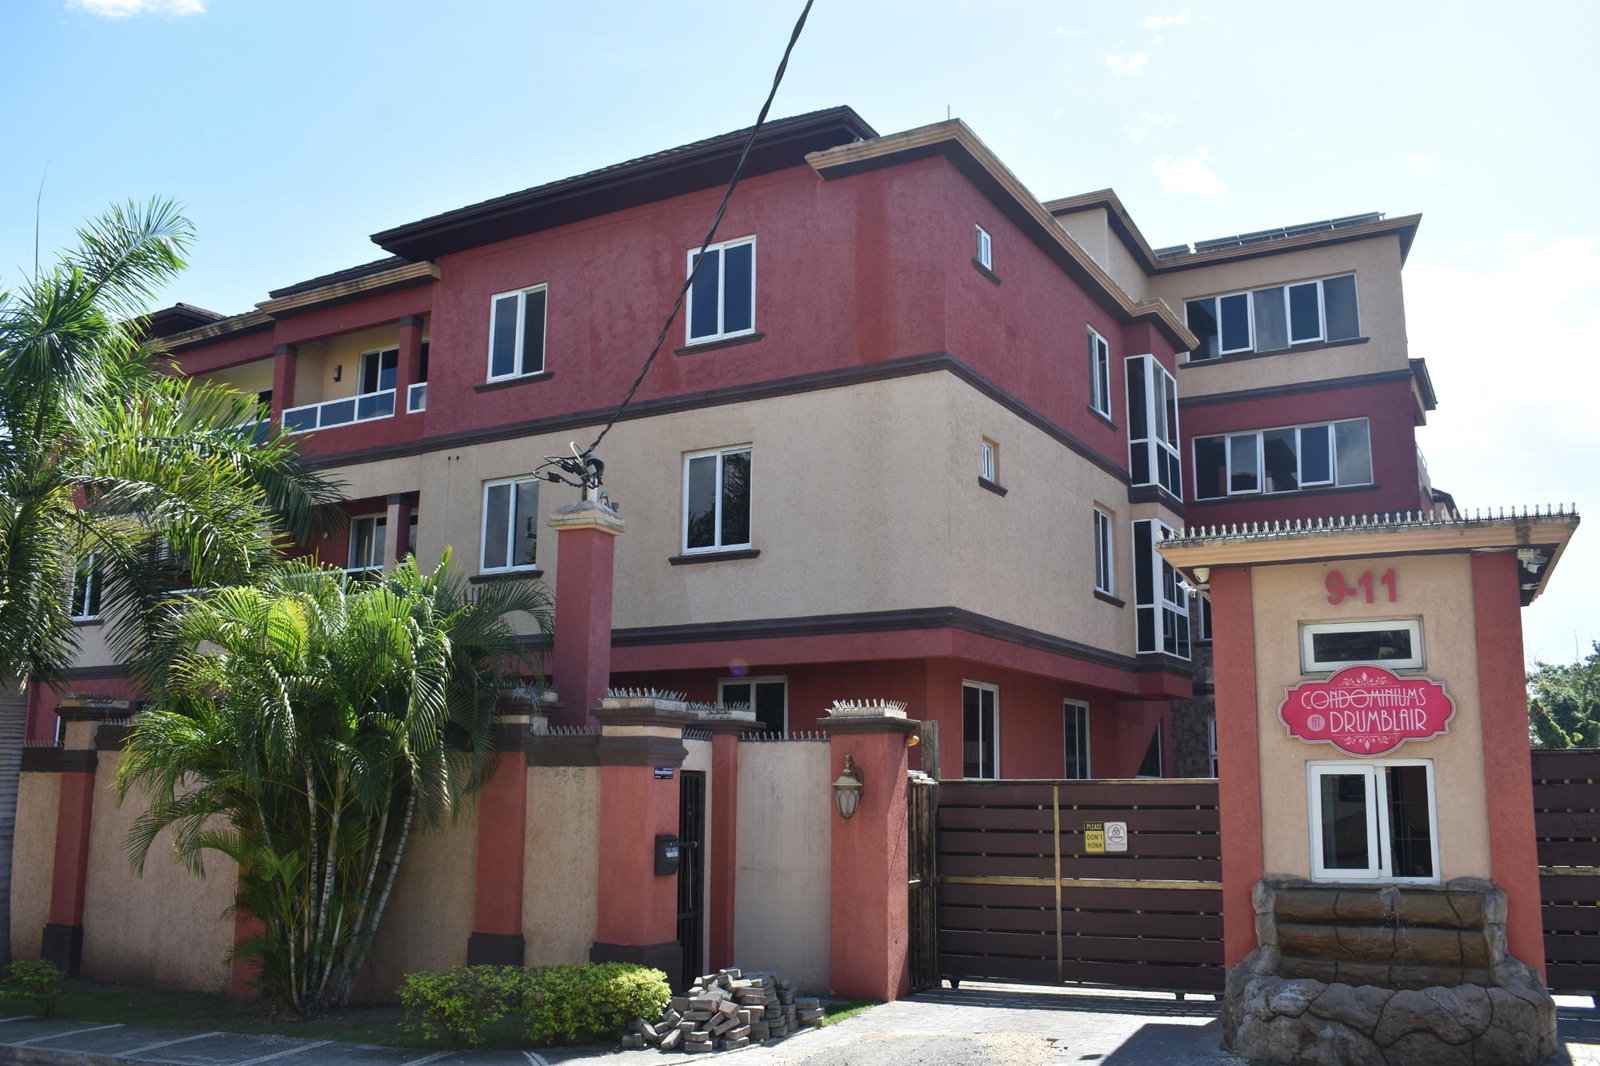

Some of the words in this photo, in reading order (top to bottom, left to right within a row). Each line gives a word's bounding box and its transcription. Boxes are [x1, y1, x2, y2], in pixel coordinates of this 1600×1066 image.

[1325, 568, 1398, 605] 9-11
[1301, 687, 1427, 710] CONDOMINIUMS
[1329, 708, 1427, 732] DRUMBLAIR
